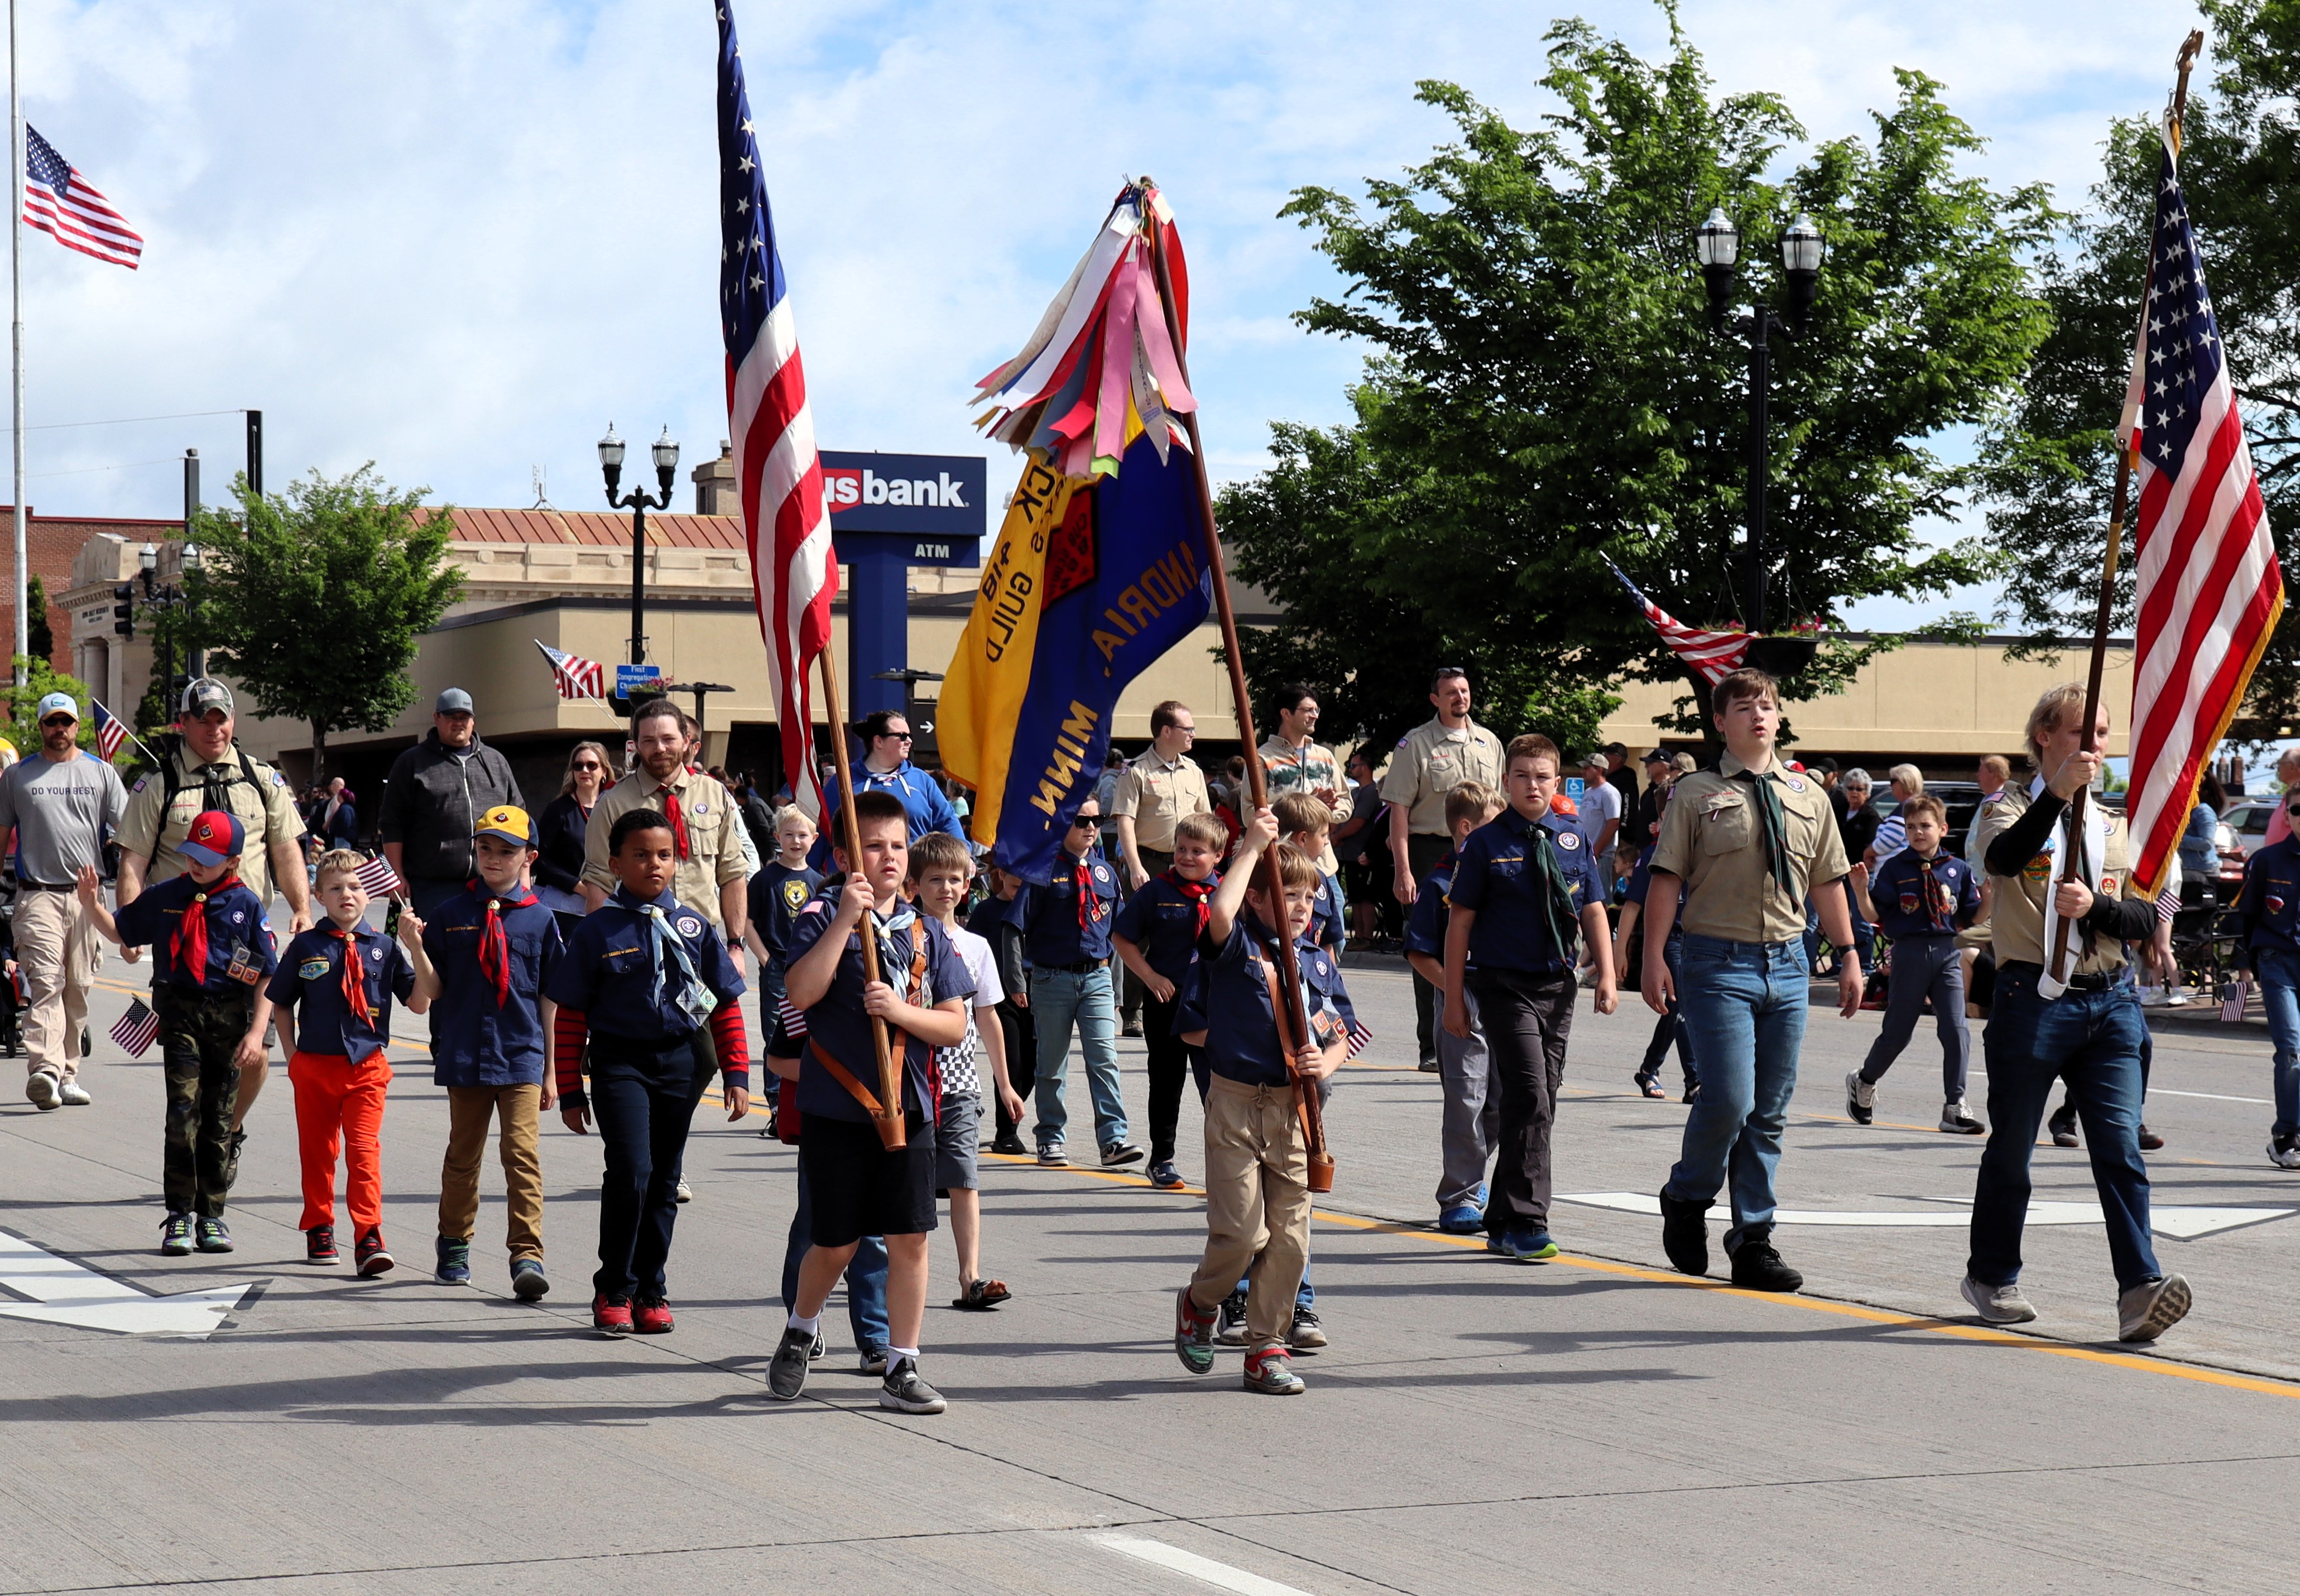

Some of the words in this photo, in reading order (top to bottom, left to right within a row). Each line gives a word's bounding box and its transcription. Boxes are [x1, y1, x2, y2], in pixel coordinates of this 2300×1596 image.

[915, 544, 949, 558] ATM
[46, 787, 70, 795] YOUR
[73, 786, 95, 795] BEST
